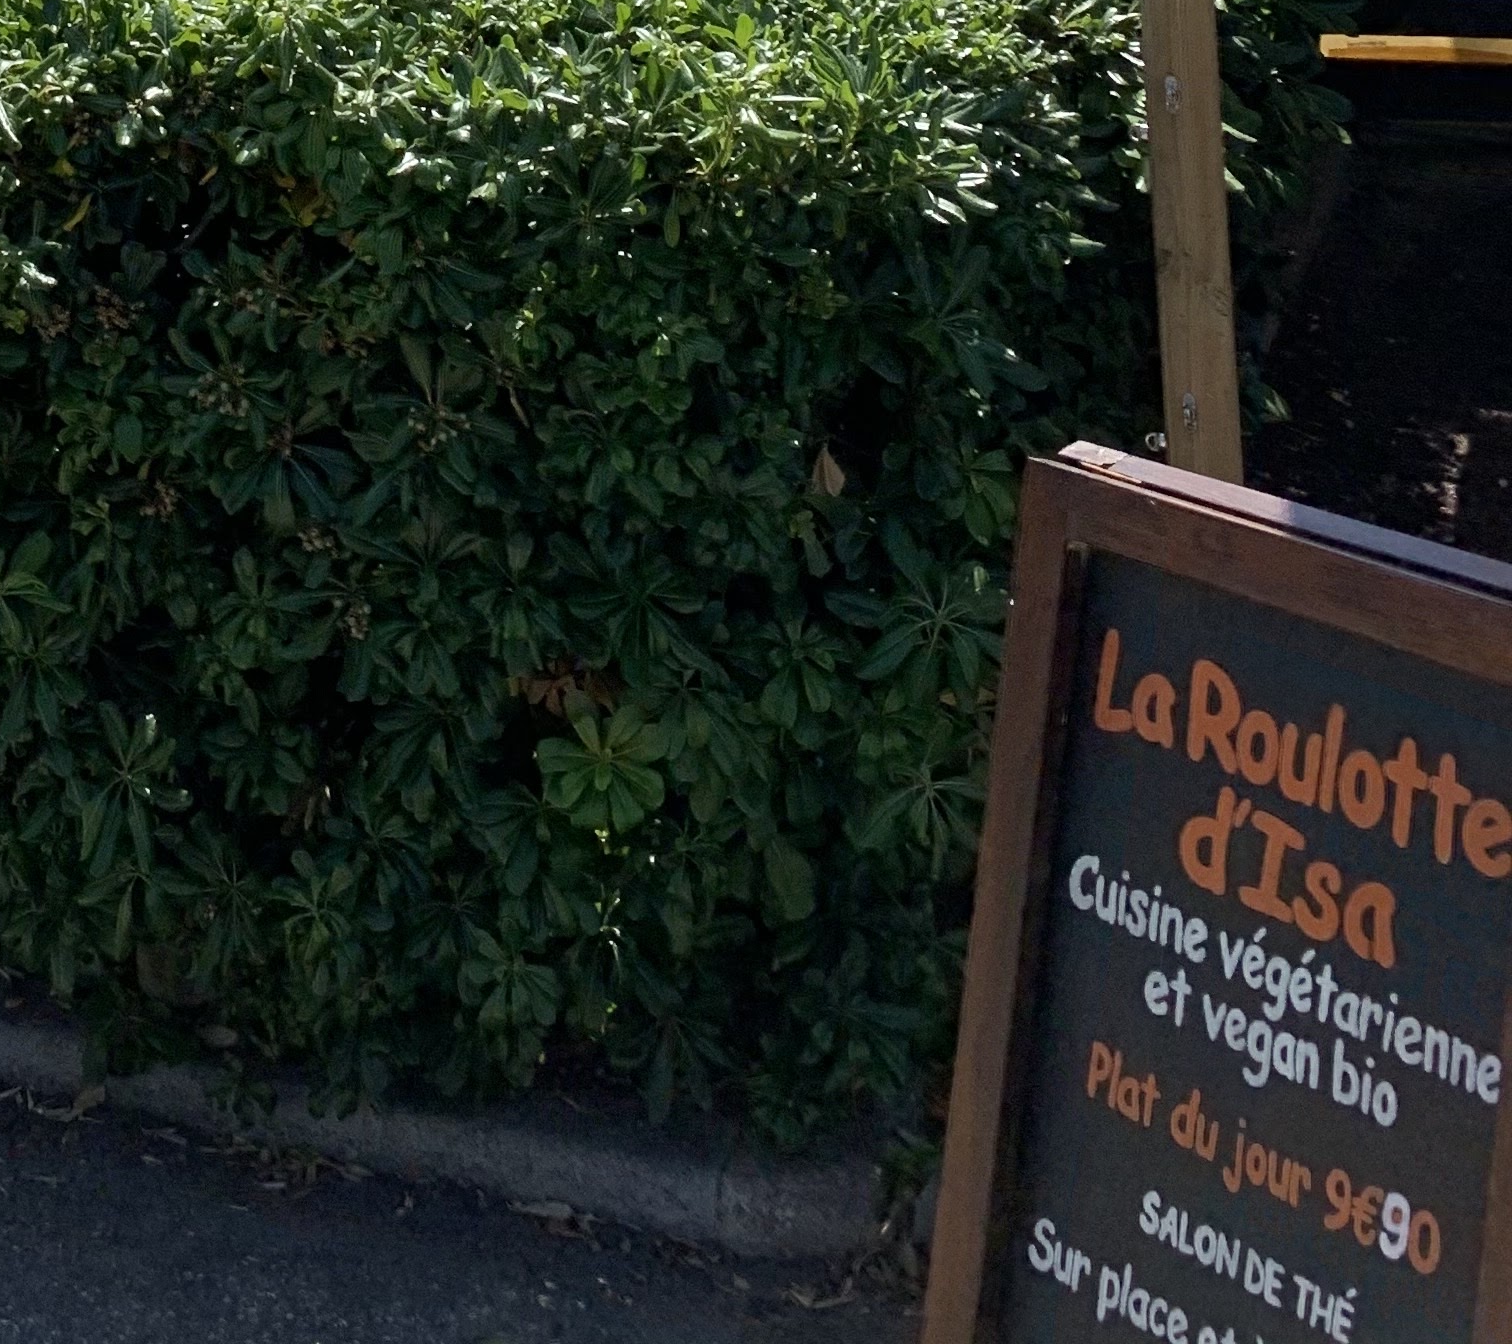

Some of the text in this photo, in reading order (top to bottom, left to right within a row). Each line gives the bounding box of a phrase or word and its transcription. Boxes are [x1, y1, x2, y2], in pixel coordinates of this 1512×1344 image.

[1094, 627, 1512, 879] La Roulotte
[1179, 786, 1396, 969] d'Isa
[1069, 855, 1501, 1105] Cuisine végétarienne
[1143, 968, 1398, 1127] et vegan bio
[1087, 1042, 1441, 1275] Plat du jour 9€90
[1028, 1217, 1189, 1344] Sur place
[1139, 1190, 1358, 1344] SALON DE THÉ
